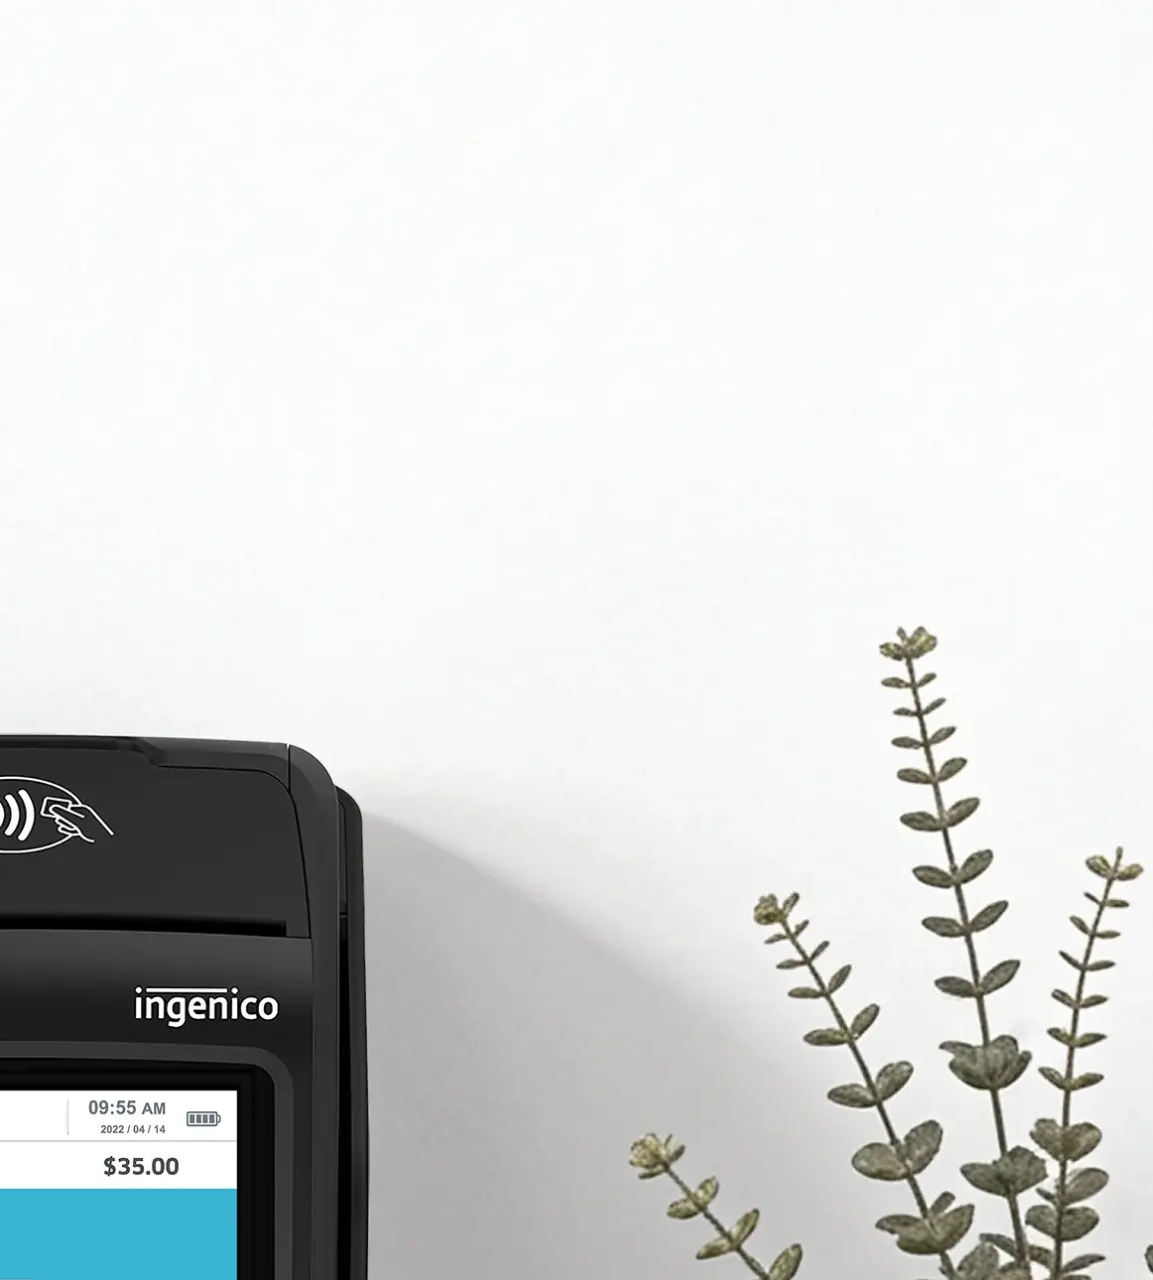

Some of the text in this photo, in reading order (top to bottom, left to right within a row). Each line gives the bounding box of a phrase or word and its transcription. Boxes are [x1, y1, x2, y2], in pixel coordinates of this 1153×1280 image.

[136, 987, 278, 1027] ingenico
[89, 1100, 165, 1114] 09:55 AM
[104, 1156, 179, 1176] $35.00
